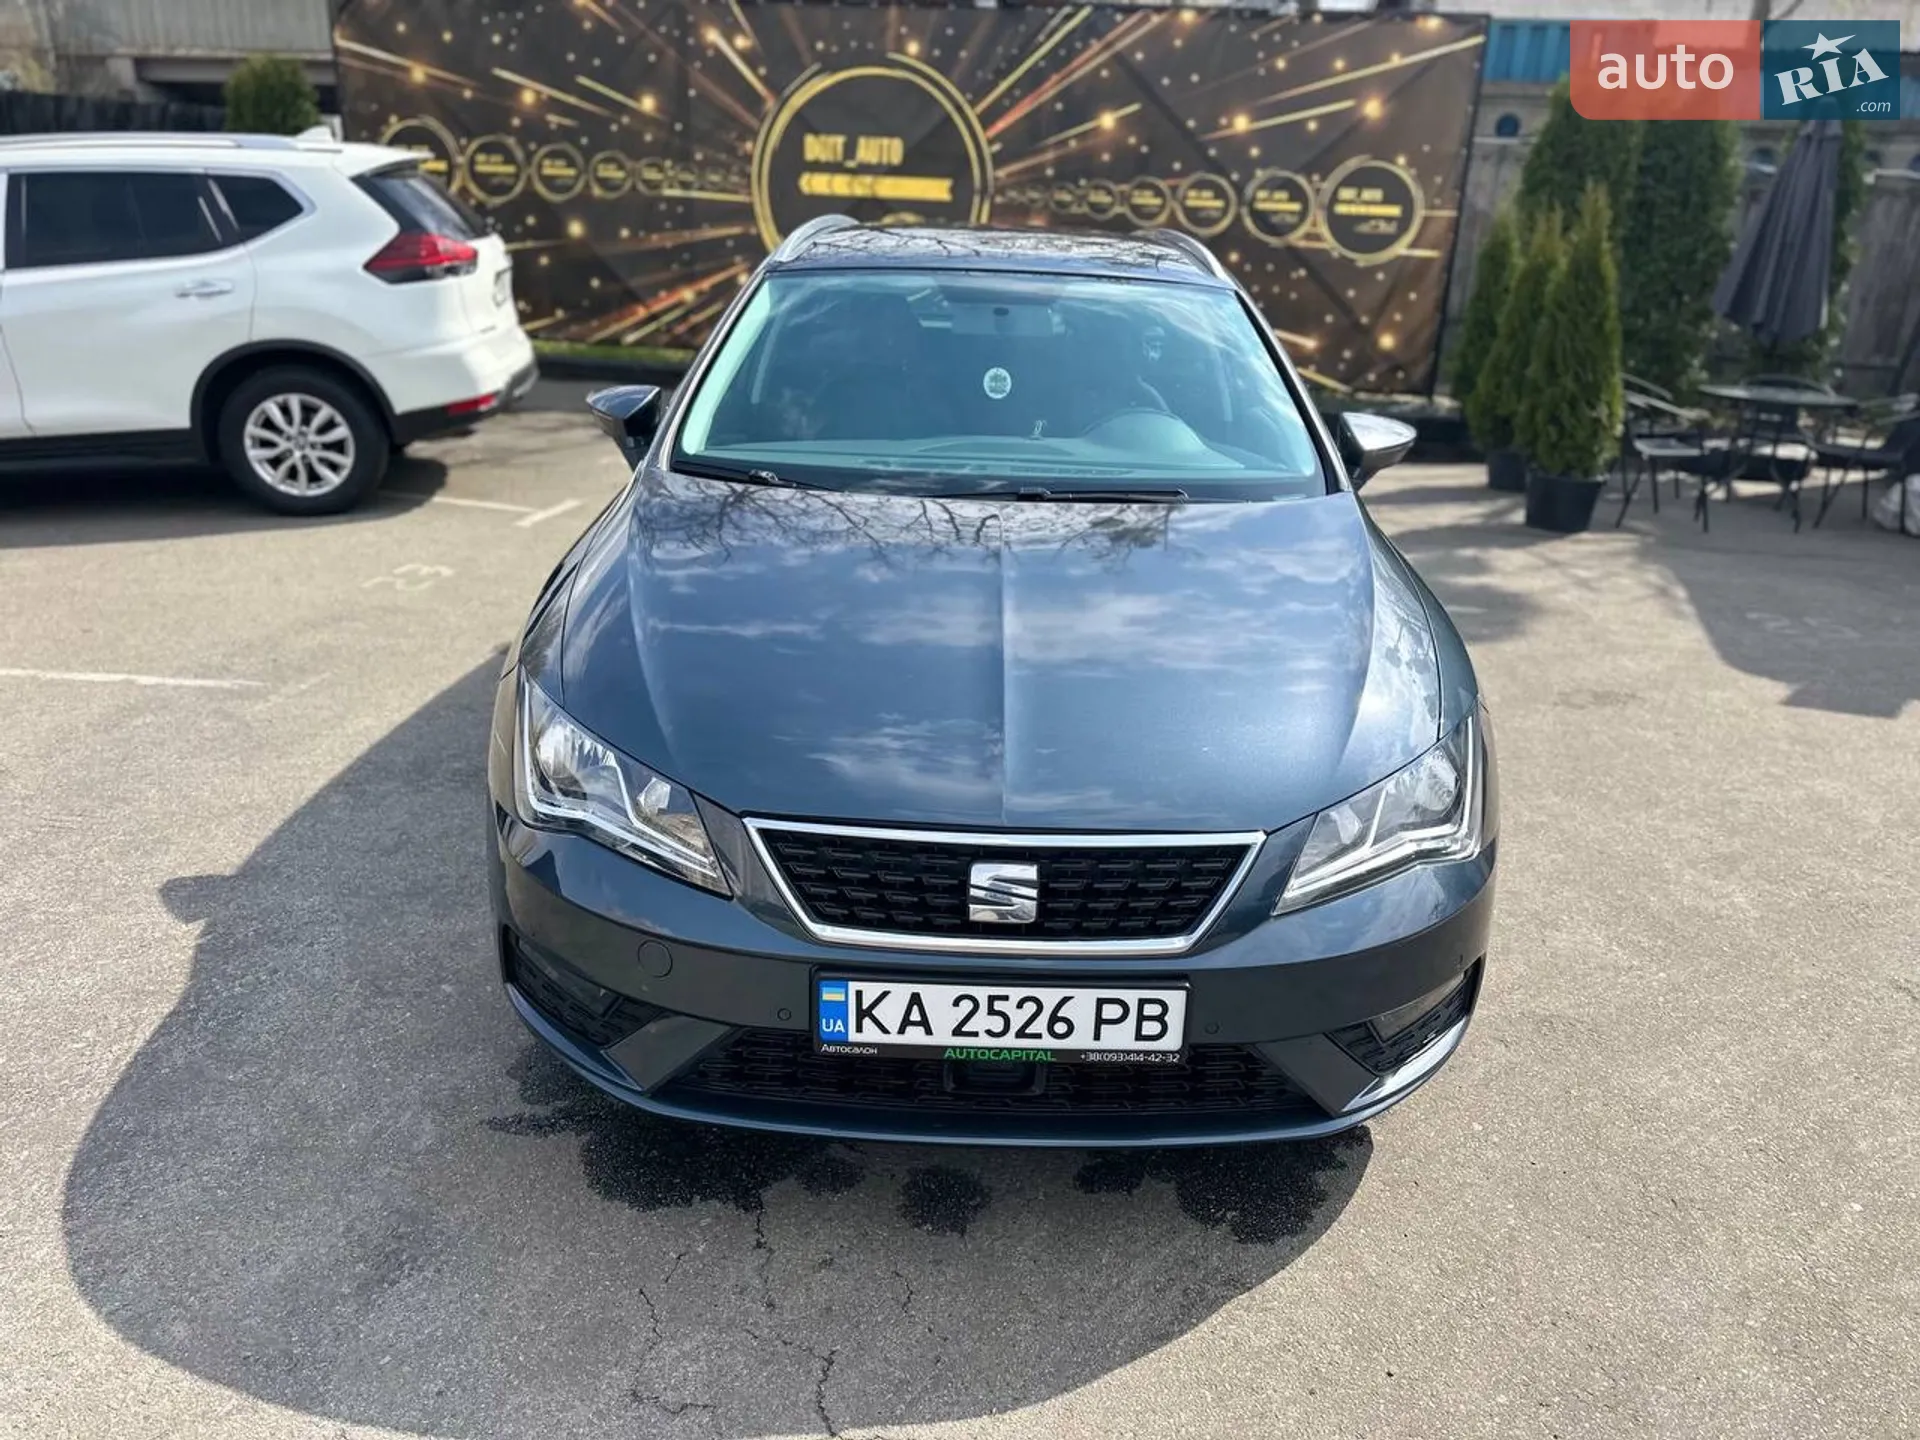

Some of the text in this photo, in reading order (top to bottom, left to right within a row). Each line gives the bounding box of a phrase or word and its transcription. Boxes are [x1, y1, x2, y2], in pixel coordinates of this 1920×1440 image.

[854, 989, 1170, 1042] KA 2526 PB
[821, 1018, 846, 1034] UA
[943, 1047, 1057, 1061] AUTOCAPITAL
